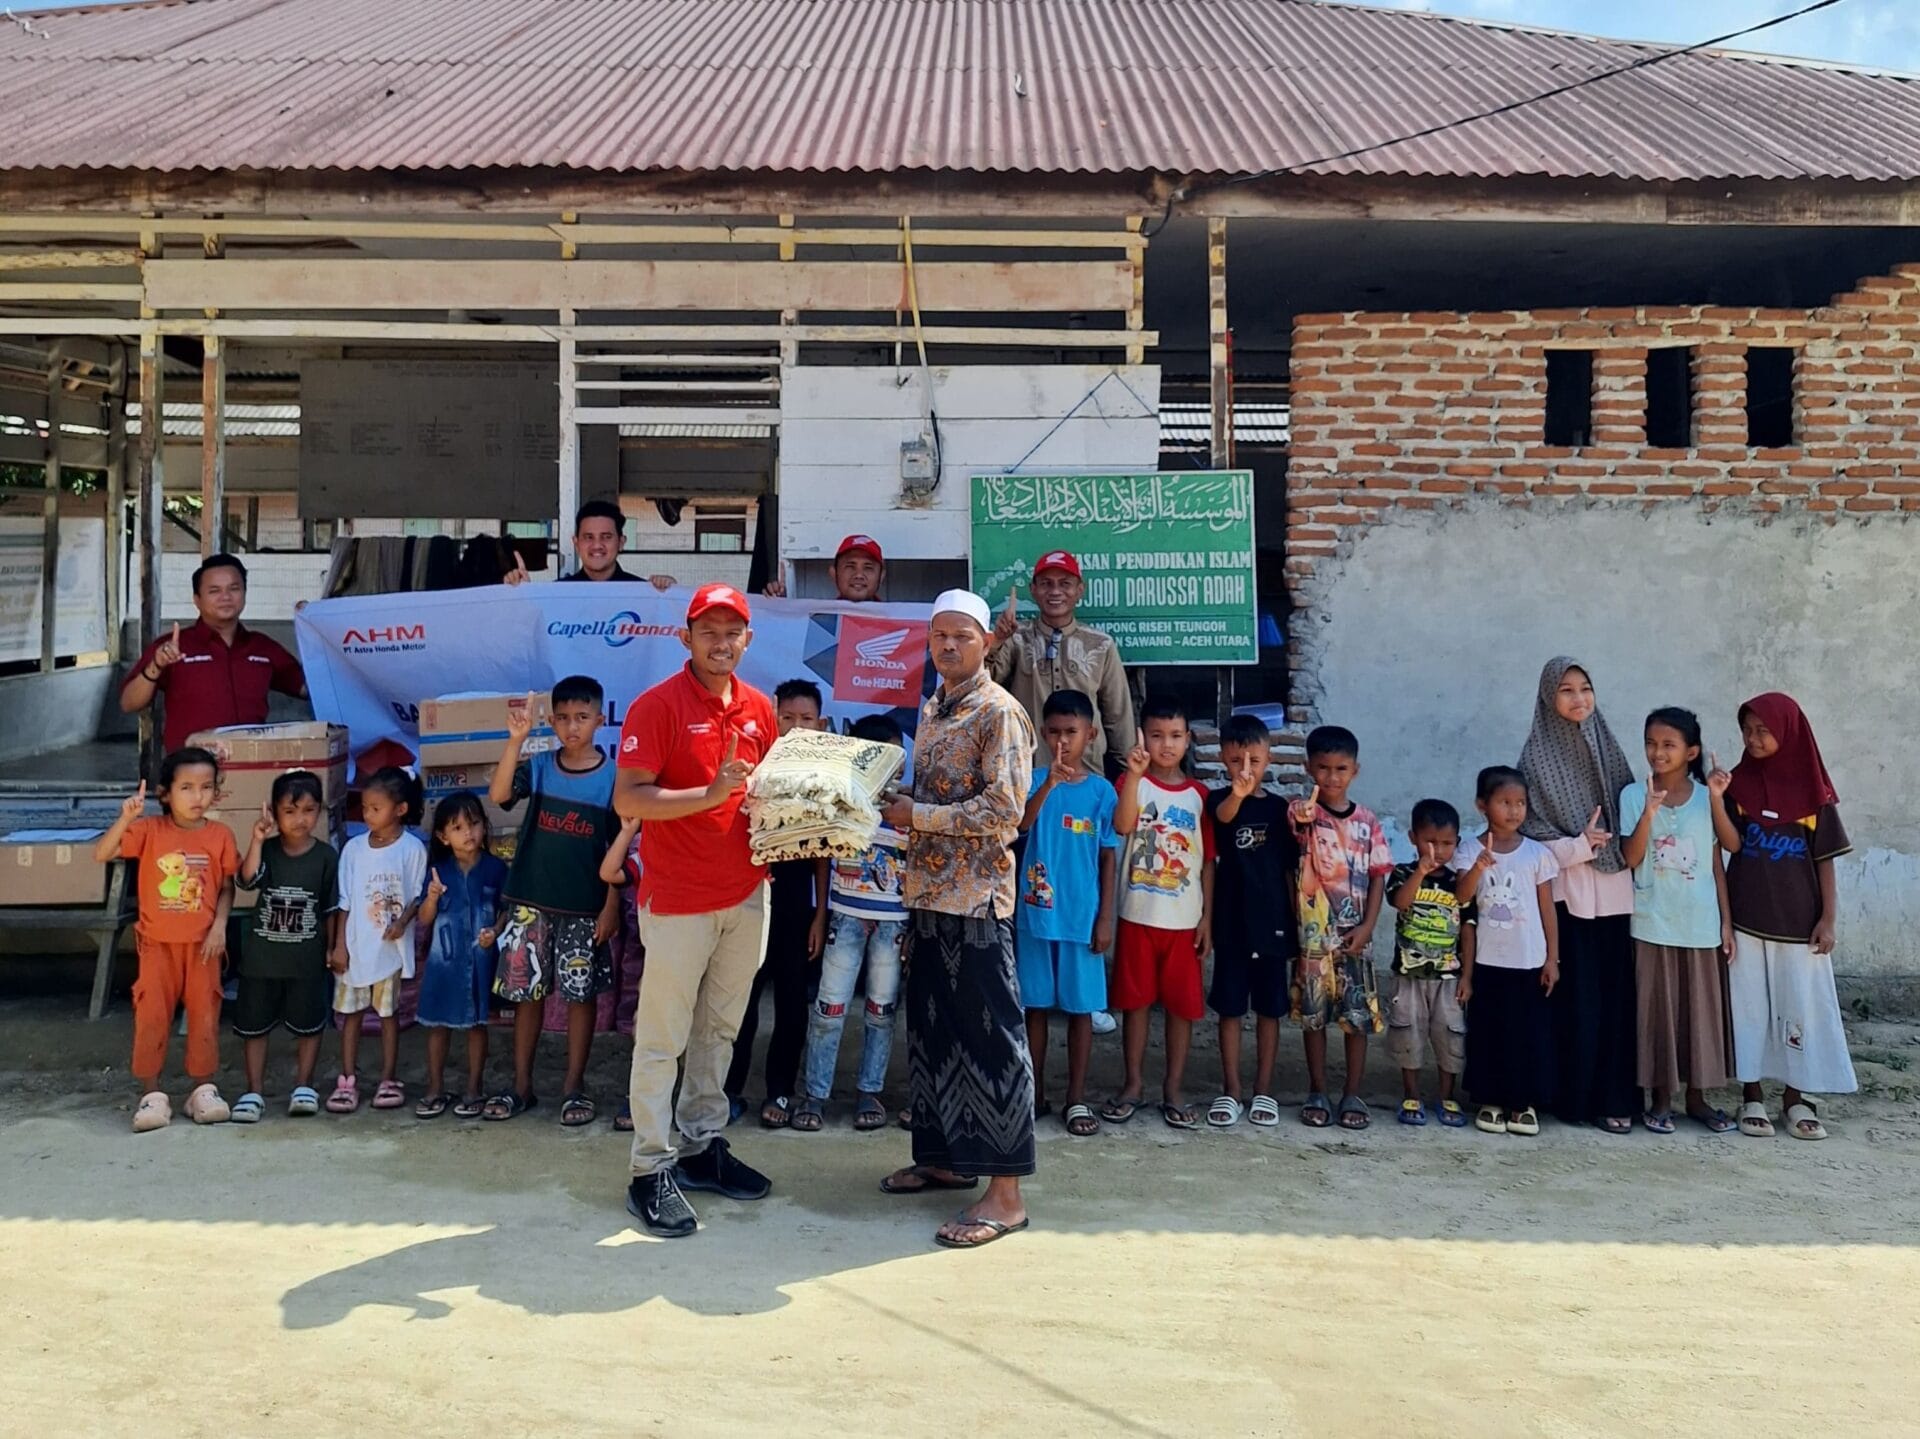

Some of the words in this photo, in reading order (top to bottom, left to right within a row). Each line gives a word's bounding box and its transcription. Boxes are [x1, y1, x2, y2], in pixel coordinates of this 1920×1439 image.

[1076, 553, 1110, 570] ASAN
[1116, 552, 1205, 569] PENDIDIKAN
[1209, 551, 1251, 569] ISLAM
[342, 624, 425, 645] AHM
[547, 621, 617, 638] Capella
[1139, 621, 1171, 633] RISEH
[1173, 620, 1227, 632] TEUNGOH
[354, 646, 373, 654] Astra
[375, 643, 400, 653] Honda
[402, 642, 426, 651] Motor
[1125, 636, 1172, 648] SAWANG
[1181, 635, 1212, 647] ACEH
[1214, 634, 1251, 646] UTARA
[854, 658, 907, 670] HONDA
[852, 676, 872, 688] One
[391, 701, 419, 723] BA
[426, 772, 467, 789] MPX2
[538, 810, 594, 836] Nevada
[1746, 823, 1806, 860] Erigo
